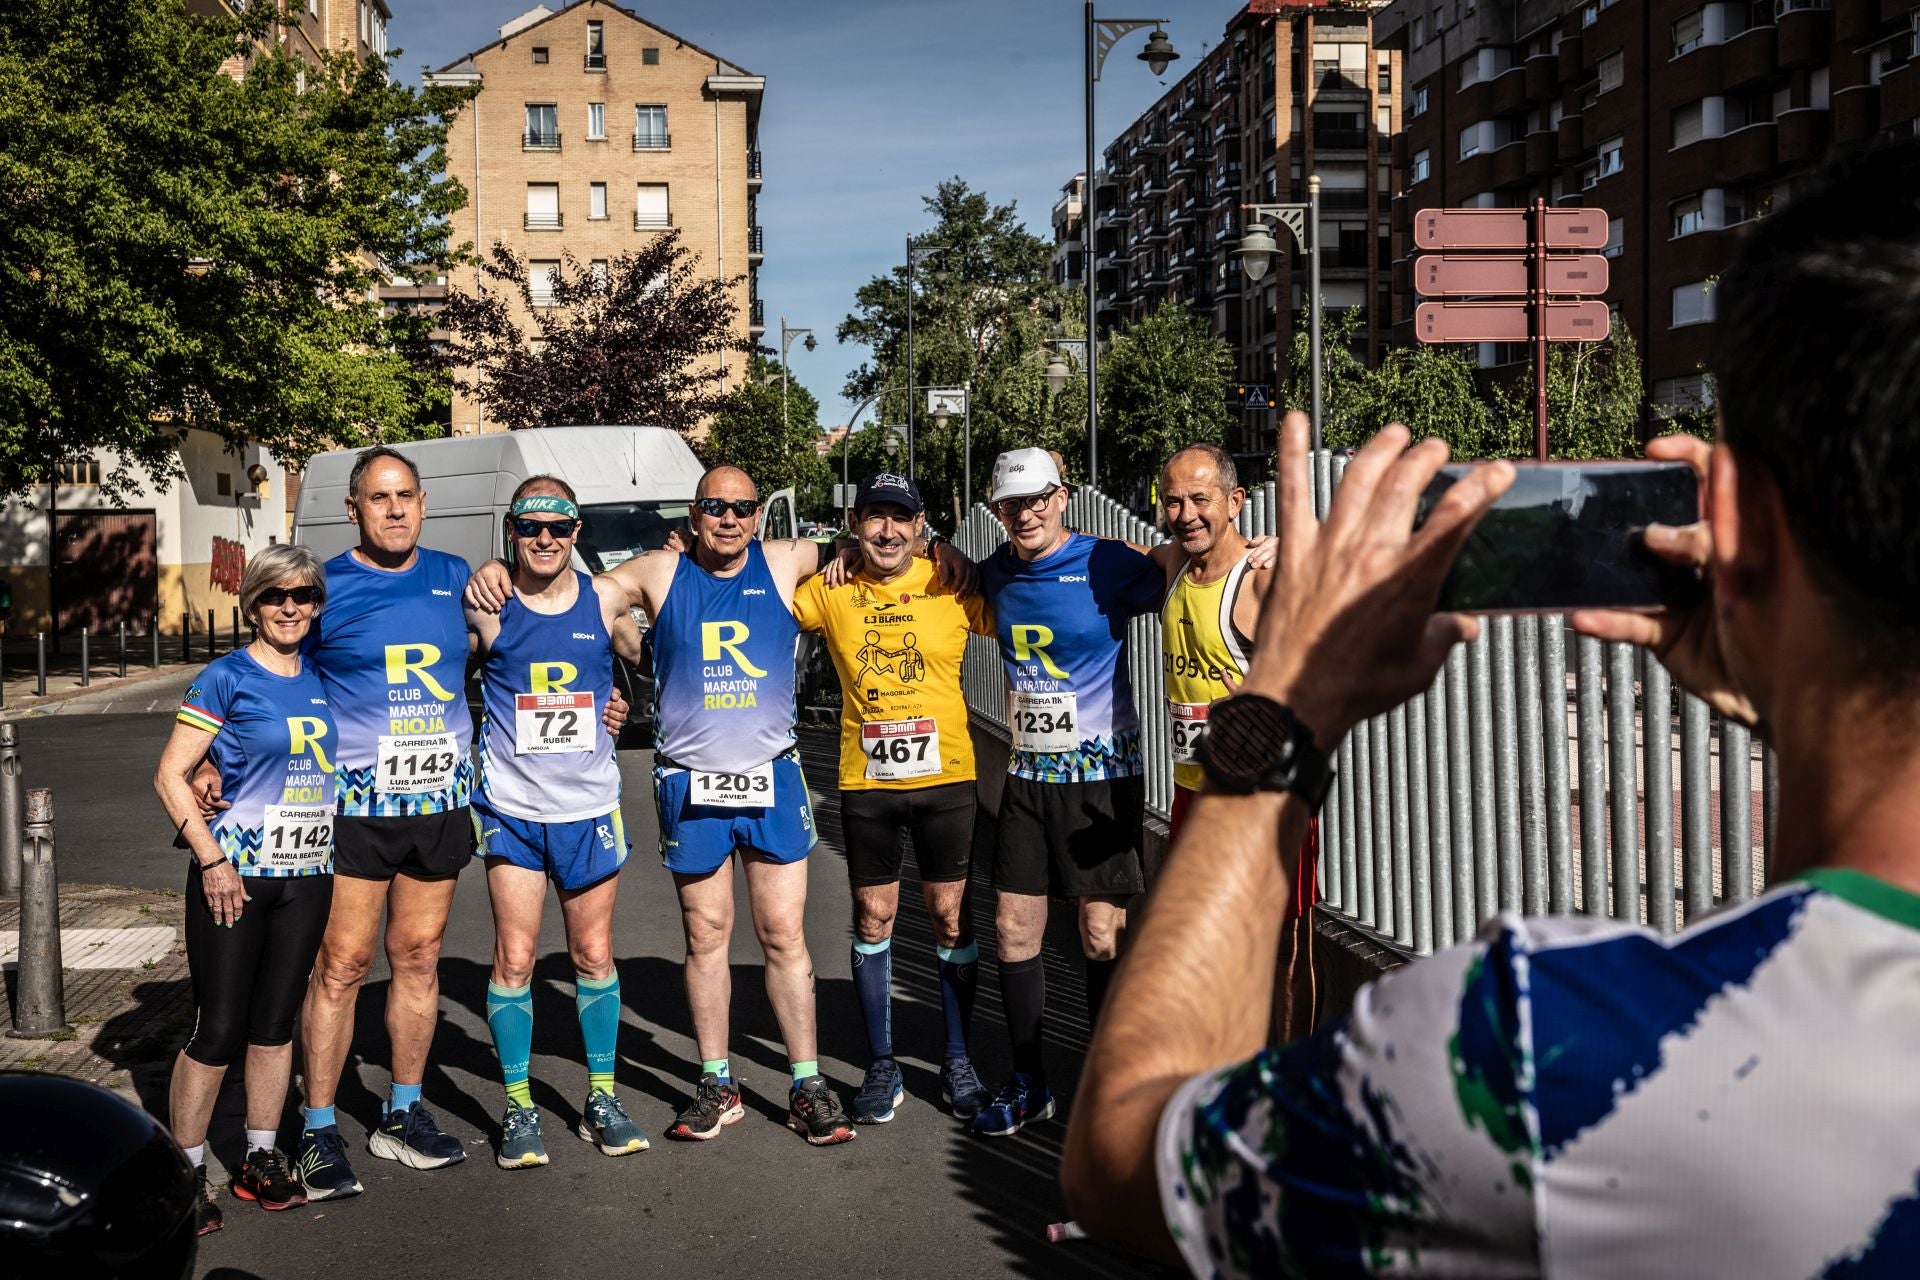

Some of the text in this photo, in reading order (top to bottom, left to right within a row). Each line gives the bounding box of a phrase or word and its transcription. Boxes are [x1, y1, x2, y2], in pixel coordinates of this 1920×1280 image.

[523, 499, 559, 509] NIKE
[879, 614, 914, 624] BLANCO
[701, 620, 768, 678] R
[1011, 624, 1070, 680] R
[385, 643, 456, 702] R
[703, 665, 733, 678] CLUB
[1017, 666, 1038, 676] CLUB
[703, 677, 757, 693] MARATÓN
[1016, 678, 1059, 691] MARATÓN
[388, 688, 422, 702] CLUB
[704, 692, 757, 710] RIOJA
[1018, 697, 1050, 705] CARRERA
[389, 701, 445, 718] MARATÓN
[390, 717, 446, 735] RIOJA
[535, 710, 578, 738] 72
[1014, 710, 1074, 734] 1234
[286, 716, 336, 774] R
[394, 739, 438, 748] CARRERA
[871, 735, 931, 764] 467
[288, 759, 312, 771] CLUB
[384, 752, 455, 776] 1143
[285, 771, 326, 787] MARATÓN
[411, 776, 445, 786] ANTONIO
[697, 774, 770, 792] 1203
[283, 787, 323, 804] RIOJA
[280, 810, 320, 819] CARRERA
[270, 824, 331, 849] 1142
[272, 850, 324, 860] MARIA BEATRIZ
